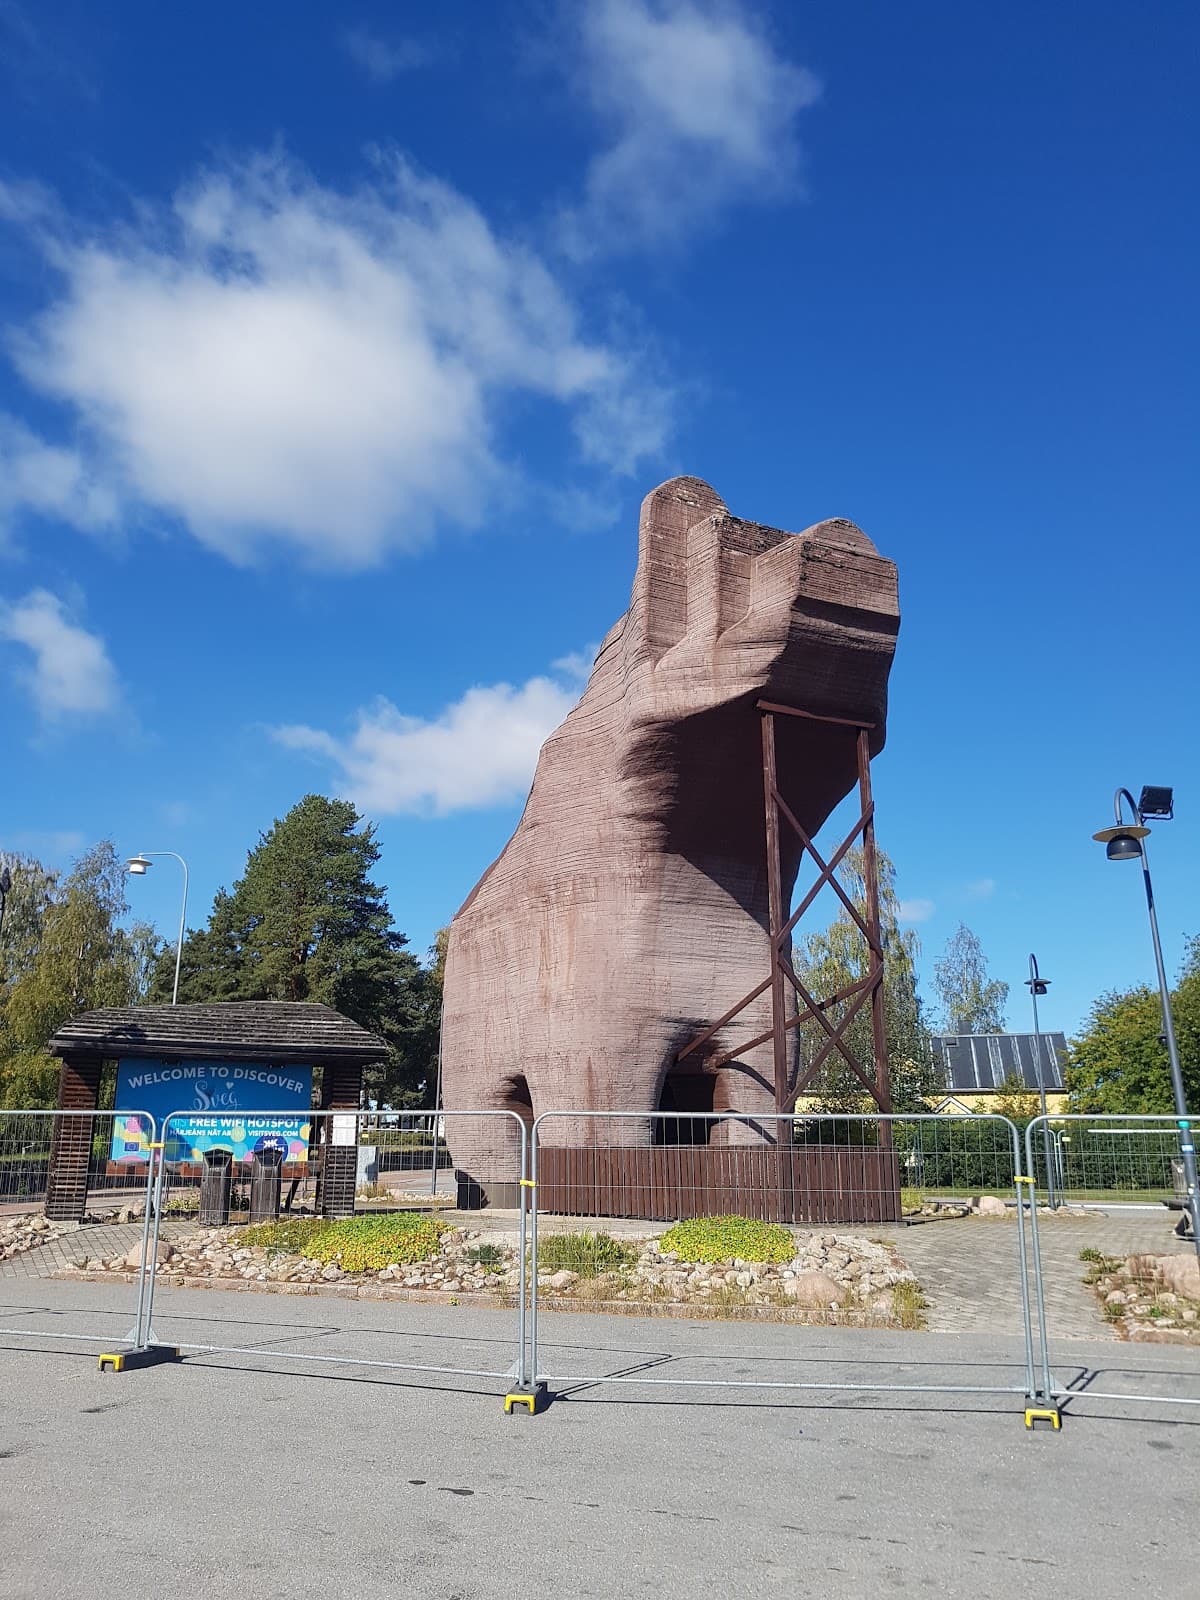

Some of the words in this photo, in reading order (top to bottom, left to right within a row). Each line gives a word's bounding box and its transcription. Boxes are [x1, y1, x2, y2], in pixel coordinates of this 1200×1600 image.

[128, 1066, 206, 1089] WELCOME
[209, 1066, 229, 1078] TO
[233, 1068, 304, 1093] DISCOVER
[193, 1080, 240, 1111] Sveg
[189, 1118, 218, 1127] FREE
[220, 1118, 245, 1128] WIFI
[247, 1118, 300, 1128] HOTSPOT
